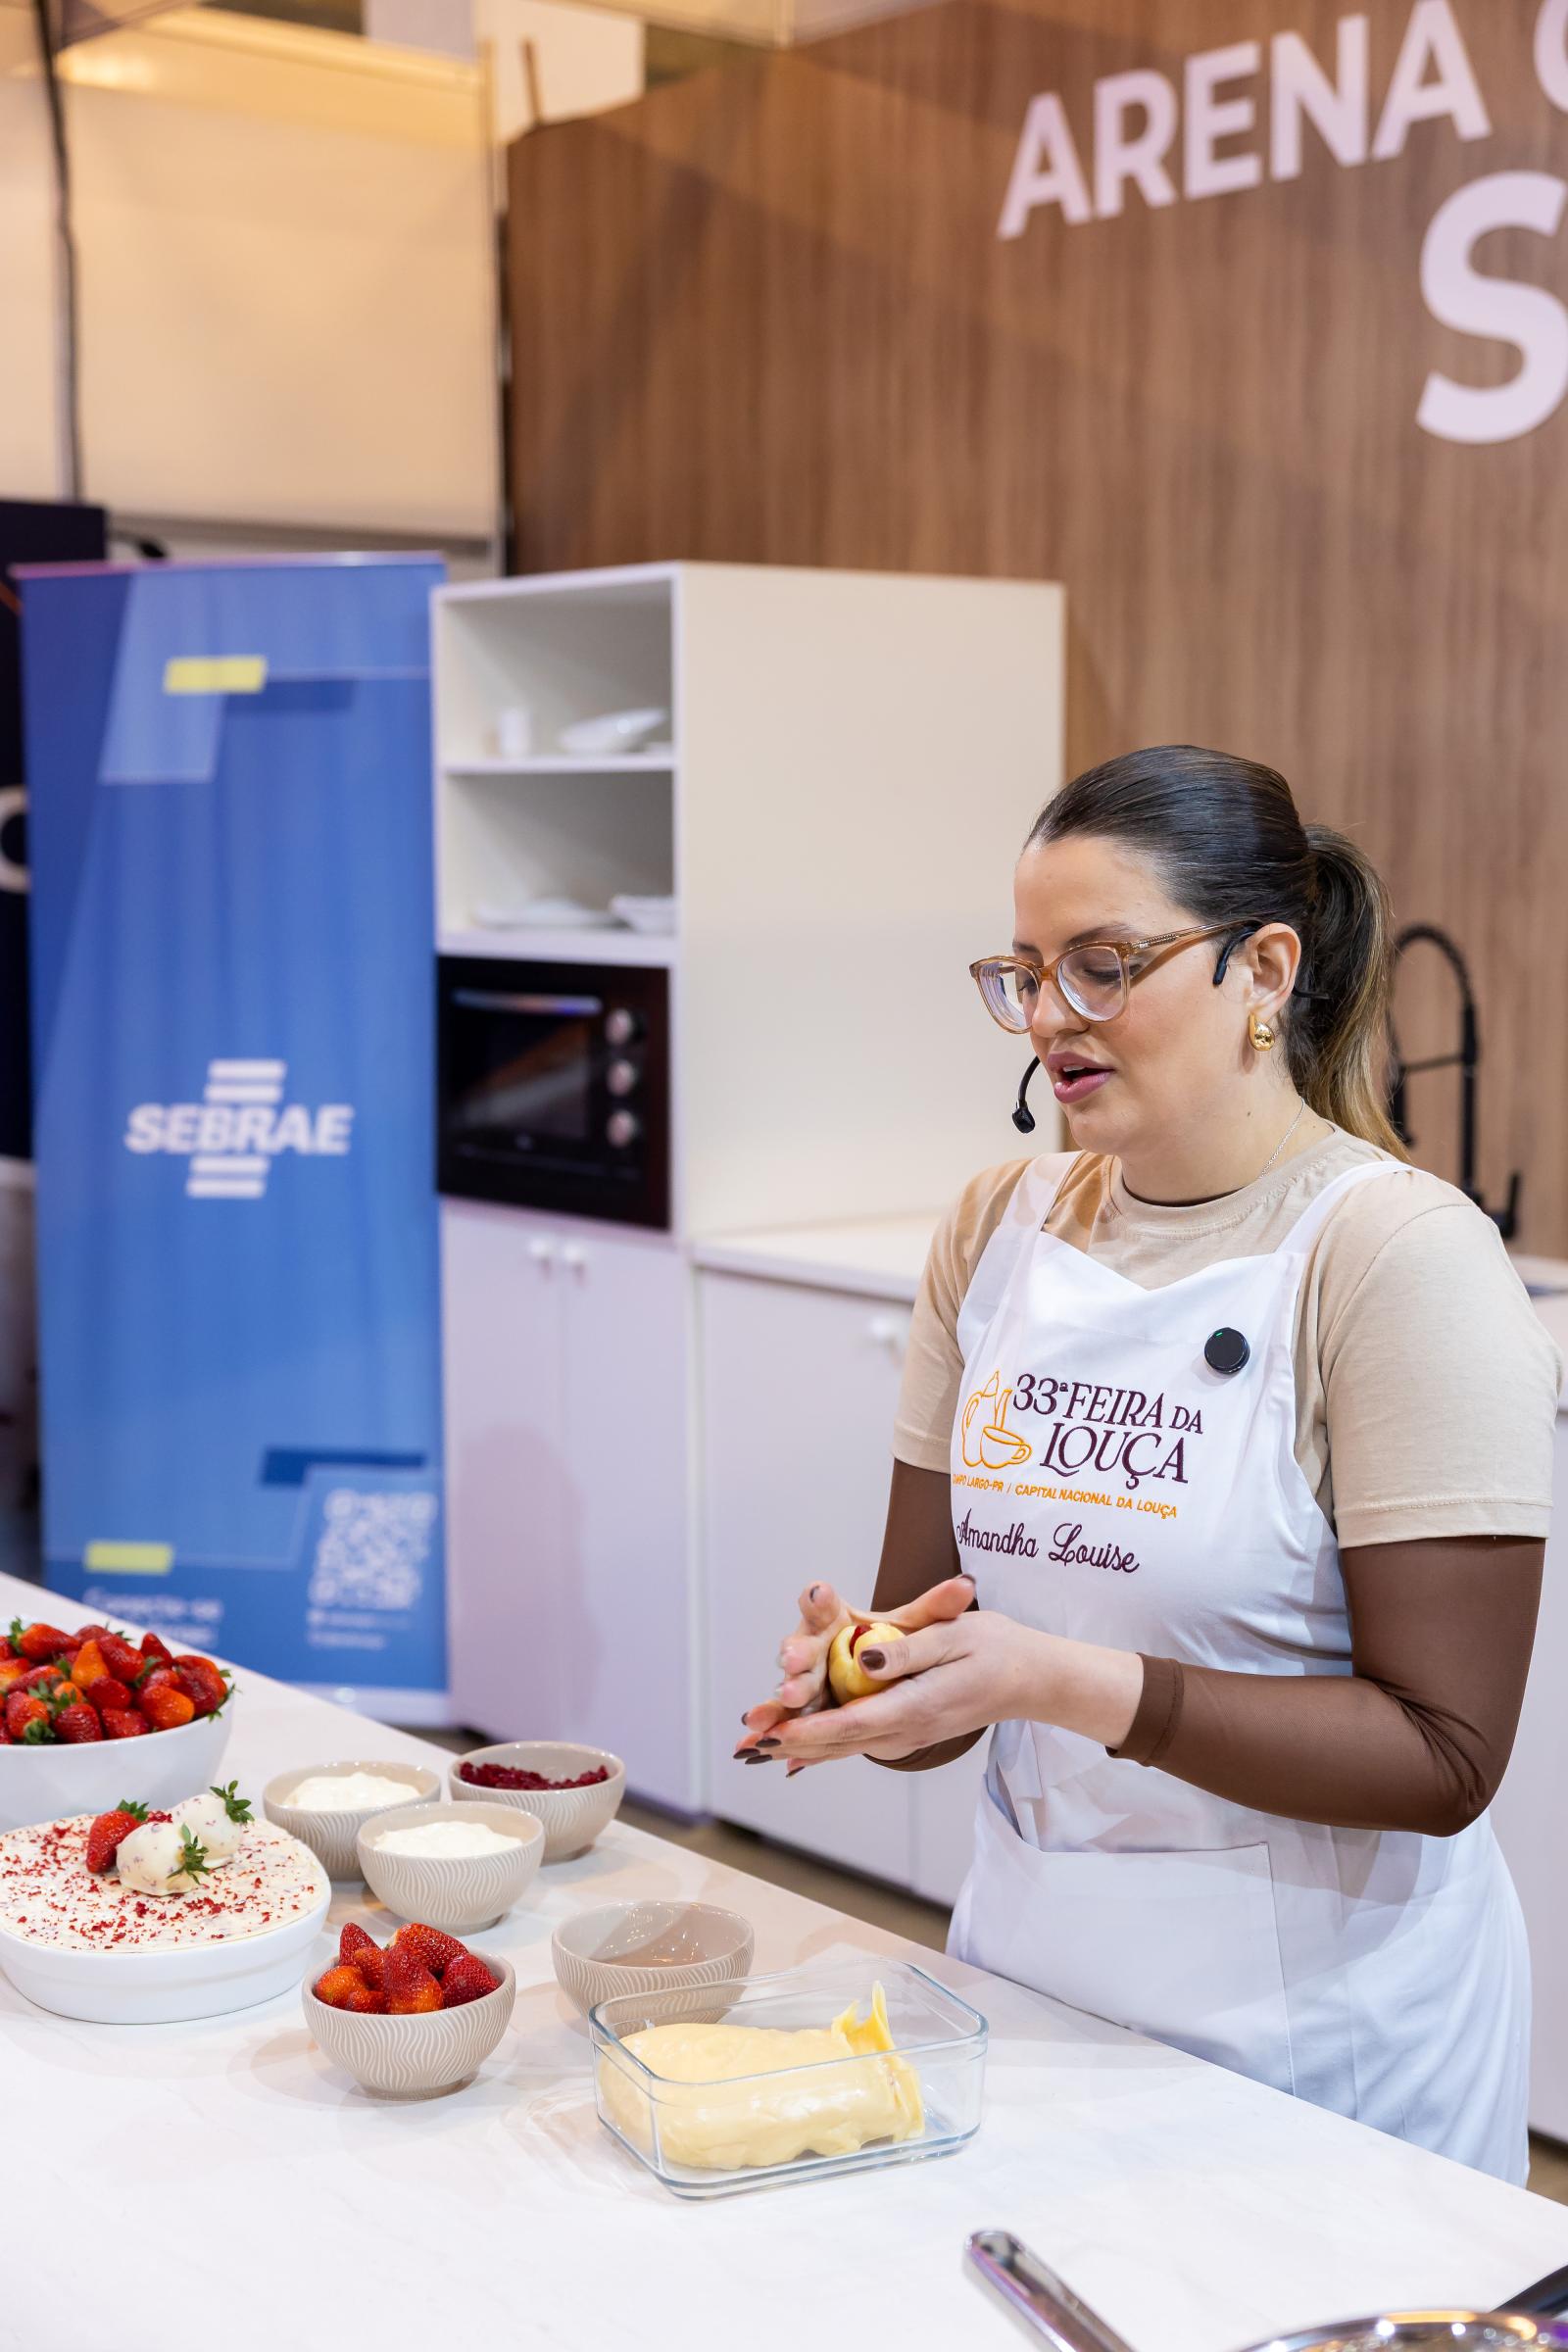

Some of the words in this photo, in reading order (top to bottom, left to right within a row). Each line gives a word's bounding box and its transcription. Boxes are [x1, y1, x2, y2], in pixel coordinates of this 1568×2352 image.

[997, 0, 1494, 241] ARENA
[124, 1102, 355, 1155] SEBRAE
[1062, 1382, 1165, 1429] FEIRA
[1169, 1405, 1204, 1435] DA
[1039, 1422, 1189, 1491] LOUÇA
[1015, 1483, 1057, 1499] CAPITAL
[1058, 1488, 1113, 1506] NACIONAL
[1116, 1495, 1133, 1510] DA
[1137, 1499, 1177, 1520] LOUÇA
[956, 1507, 1040, 1558] Amandha
[1049, 1523, 1141, 1574] Louise
